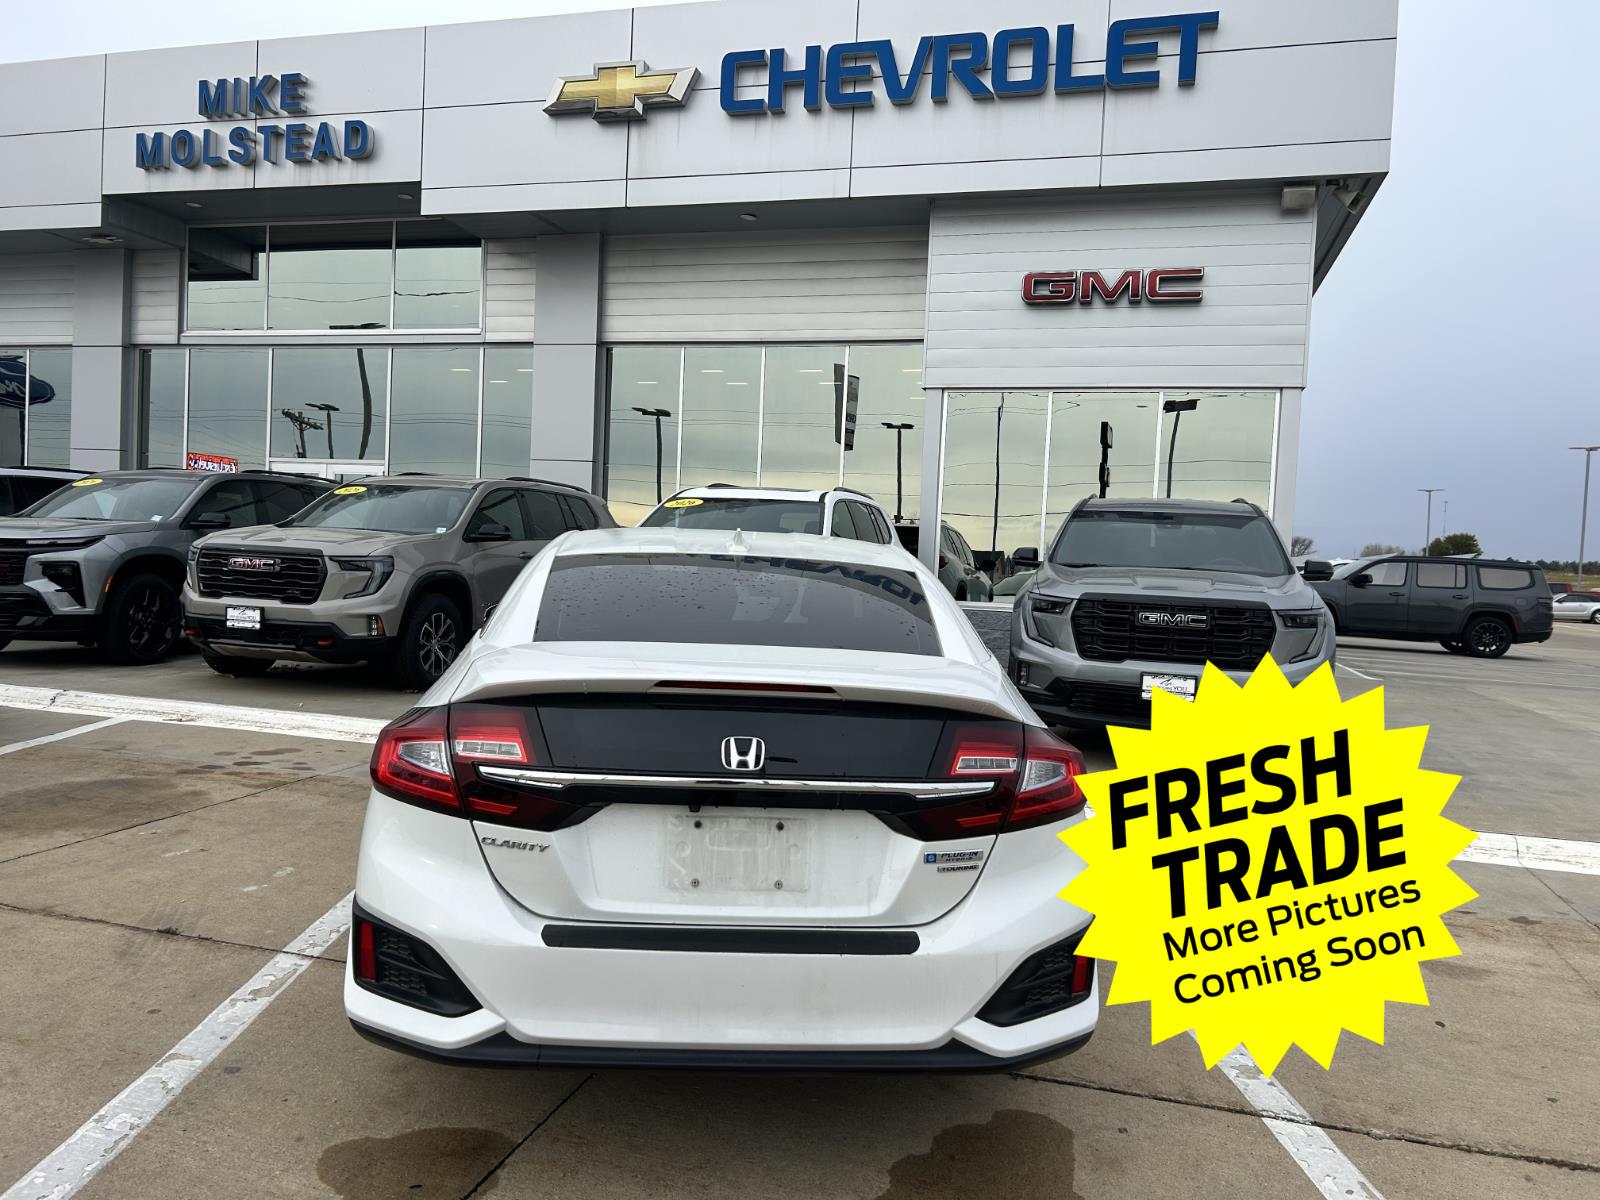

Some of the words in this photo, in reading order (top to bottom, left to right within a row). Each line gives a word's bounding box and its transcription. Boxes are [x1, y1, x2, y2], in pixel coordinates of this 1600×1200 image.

[720, 11, 1219, 115] CHEVROLET
[198, 72, 309, 119] MIKE
[136, 119, 375, 170] MOLSTEAD
[1021, 266, 1204, 307] GMC
[228, 556, 277, 572] GMC
[1138, 611, 1207, 629] GMC
[481, 836, 550, 853] CLARITY
